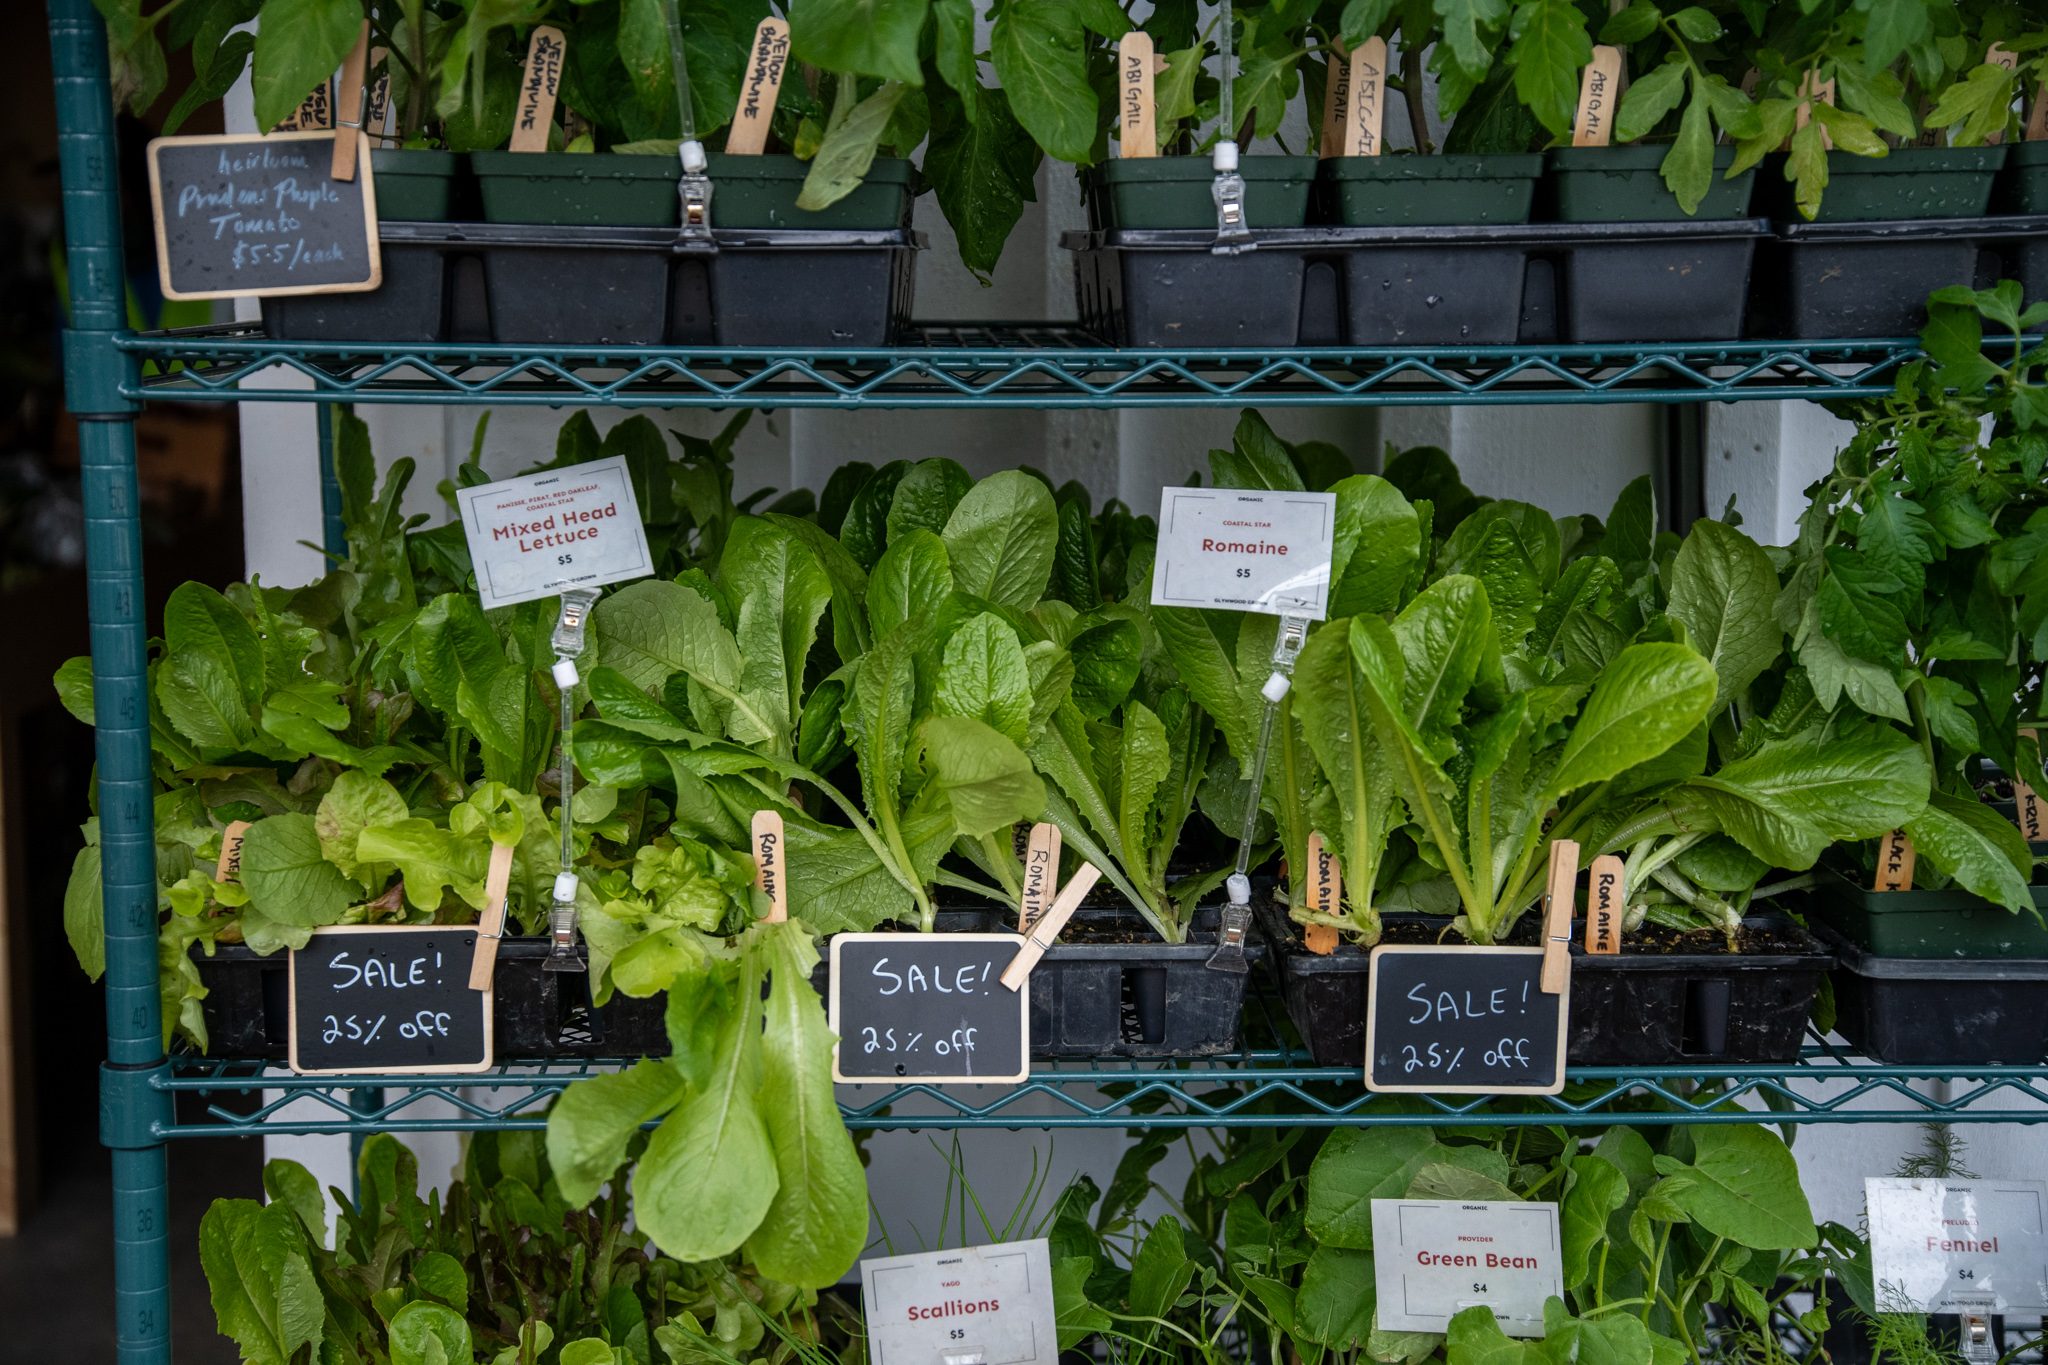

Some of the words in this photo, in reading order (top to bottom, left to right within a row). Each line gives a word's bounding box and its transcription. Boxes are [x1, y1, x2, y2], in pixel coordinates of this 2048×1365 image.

[545, 41, 562, 96] YELLOW
[1125, 56, 1142, 128] ABIGAIL
[1585, 69, 1607, 139] ABIGAIL
[209, 212, 300, 240] Tomato
[534, 477, 560, 487] ORGANIC
[526, 502, 556, 512] COASTAL
[557, 497, 574, 505] STAR
[492, 515, 555, 541] Mixed
[562, 502, 618, 527] Head
[1223, 520, 1253, 528] COASTAL
[519, 525, 599, 553] Lettuce
[1202, 538, 1288, 556] Romaine
[557, 554, 573, 565] $5
[1236, 568, 1251, 578] $5
[2024, 794, 2040, 840] KRIM
[760, 833, 777, 903] ROMAIN
[1597, 873, 1615, 951] ROMAINE
[329, 952, 442, 989] SALE!
[872, 957, 992, 995] SALE!
[1407, 980, 1529, 1024] SALE!
[322, 1014, 386, 1045] 25%
[861, 1026, 923, 1054] 25%
[1402, 1042, 1465, 1074] 25%
[137, 1208, 152, 1232] 36
[1926, 1236, 1999, 1253] Fennel
[937, 1258, 963, 1266] ORGANIC
[1417, 1251, 1477, 1267] Green
[1486, 1253, 1538, 1269] Bean
[941, 1280, 961, 1288] YAGO
[1958, 1269, 1974, 1280] $4
[1473, 1283, 1488, 1293] $4
[908, 1299, 1000, 1321] Scallions
[950, 1329, 965, 1340] $5
